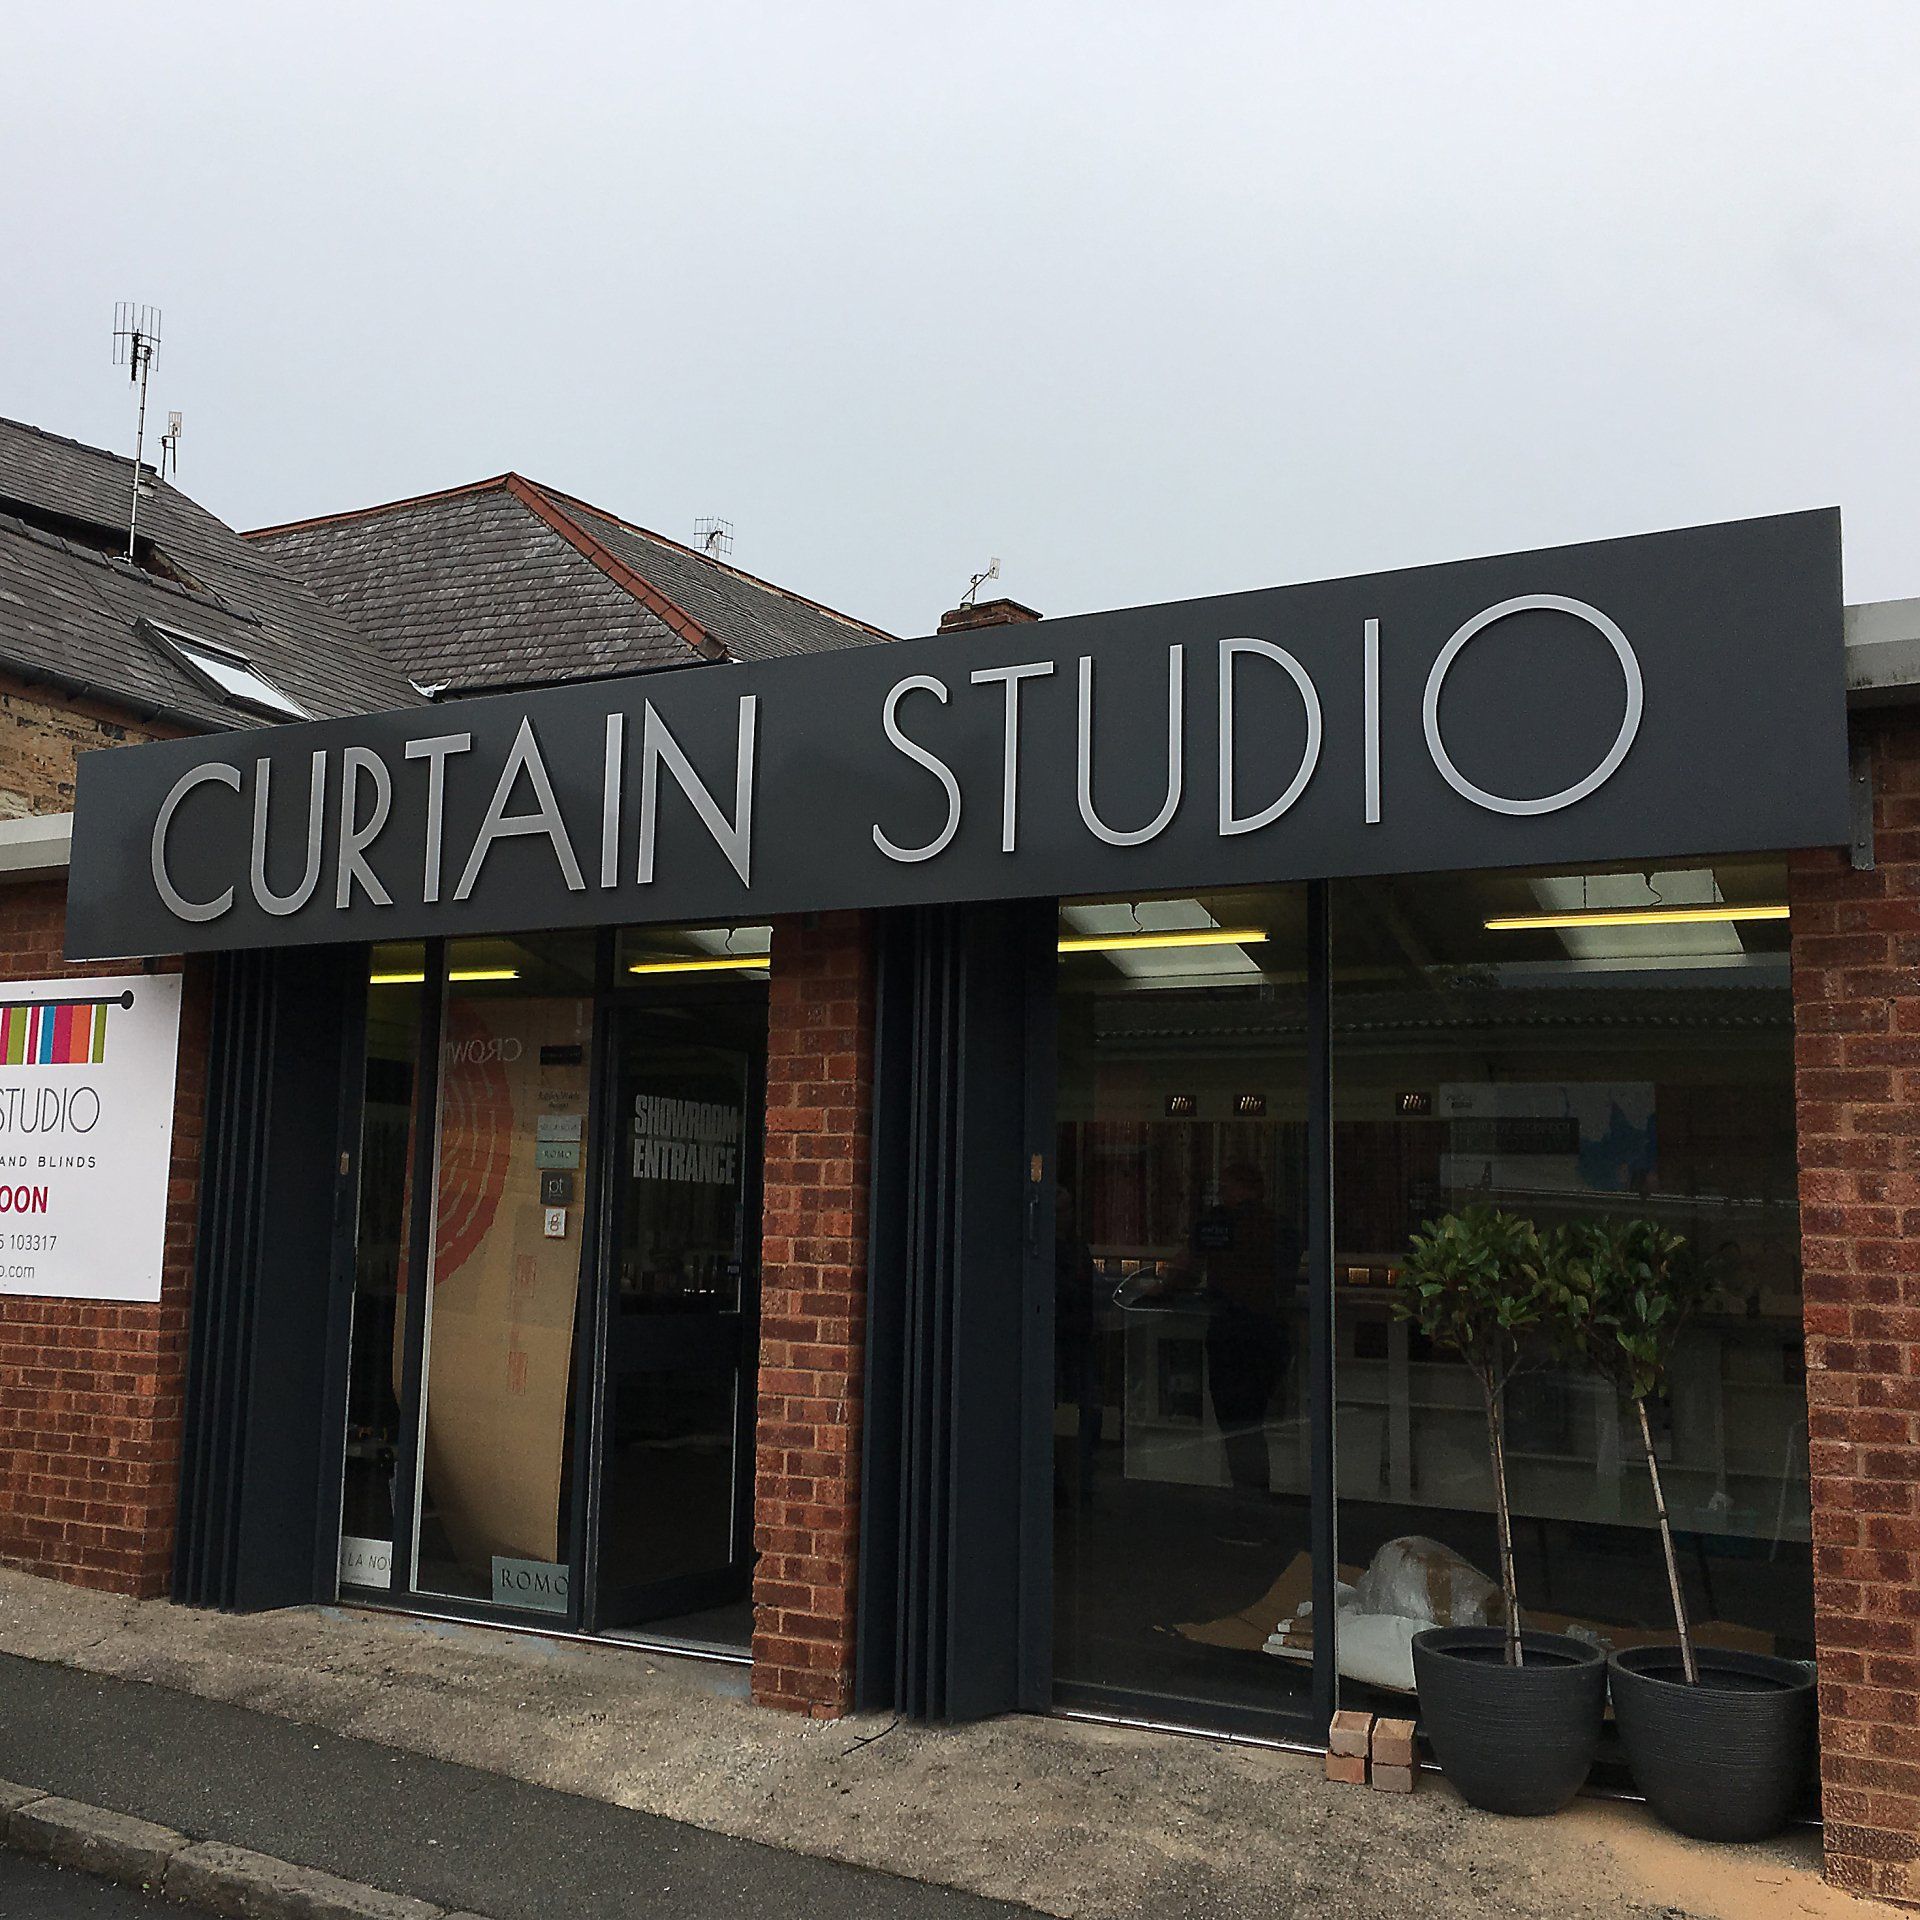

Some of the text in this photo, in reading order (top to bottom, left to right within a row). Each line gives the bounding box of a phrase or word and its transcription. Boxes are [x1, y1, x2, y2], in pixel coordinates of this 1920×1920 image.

[151, 593, 1645, 922] CURTAIN STUDIO
[634, 1094, 738, 1144] SHOWROOM
[38, 1156, 96, 1169] BLINDS
[633, 1138, 737, 1185] ENTRANCE
[10, 1234, 57, 1251] 103317
[501, 1568, 568, 1595] ROMO
